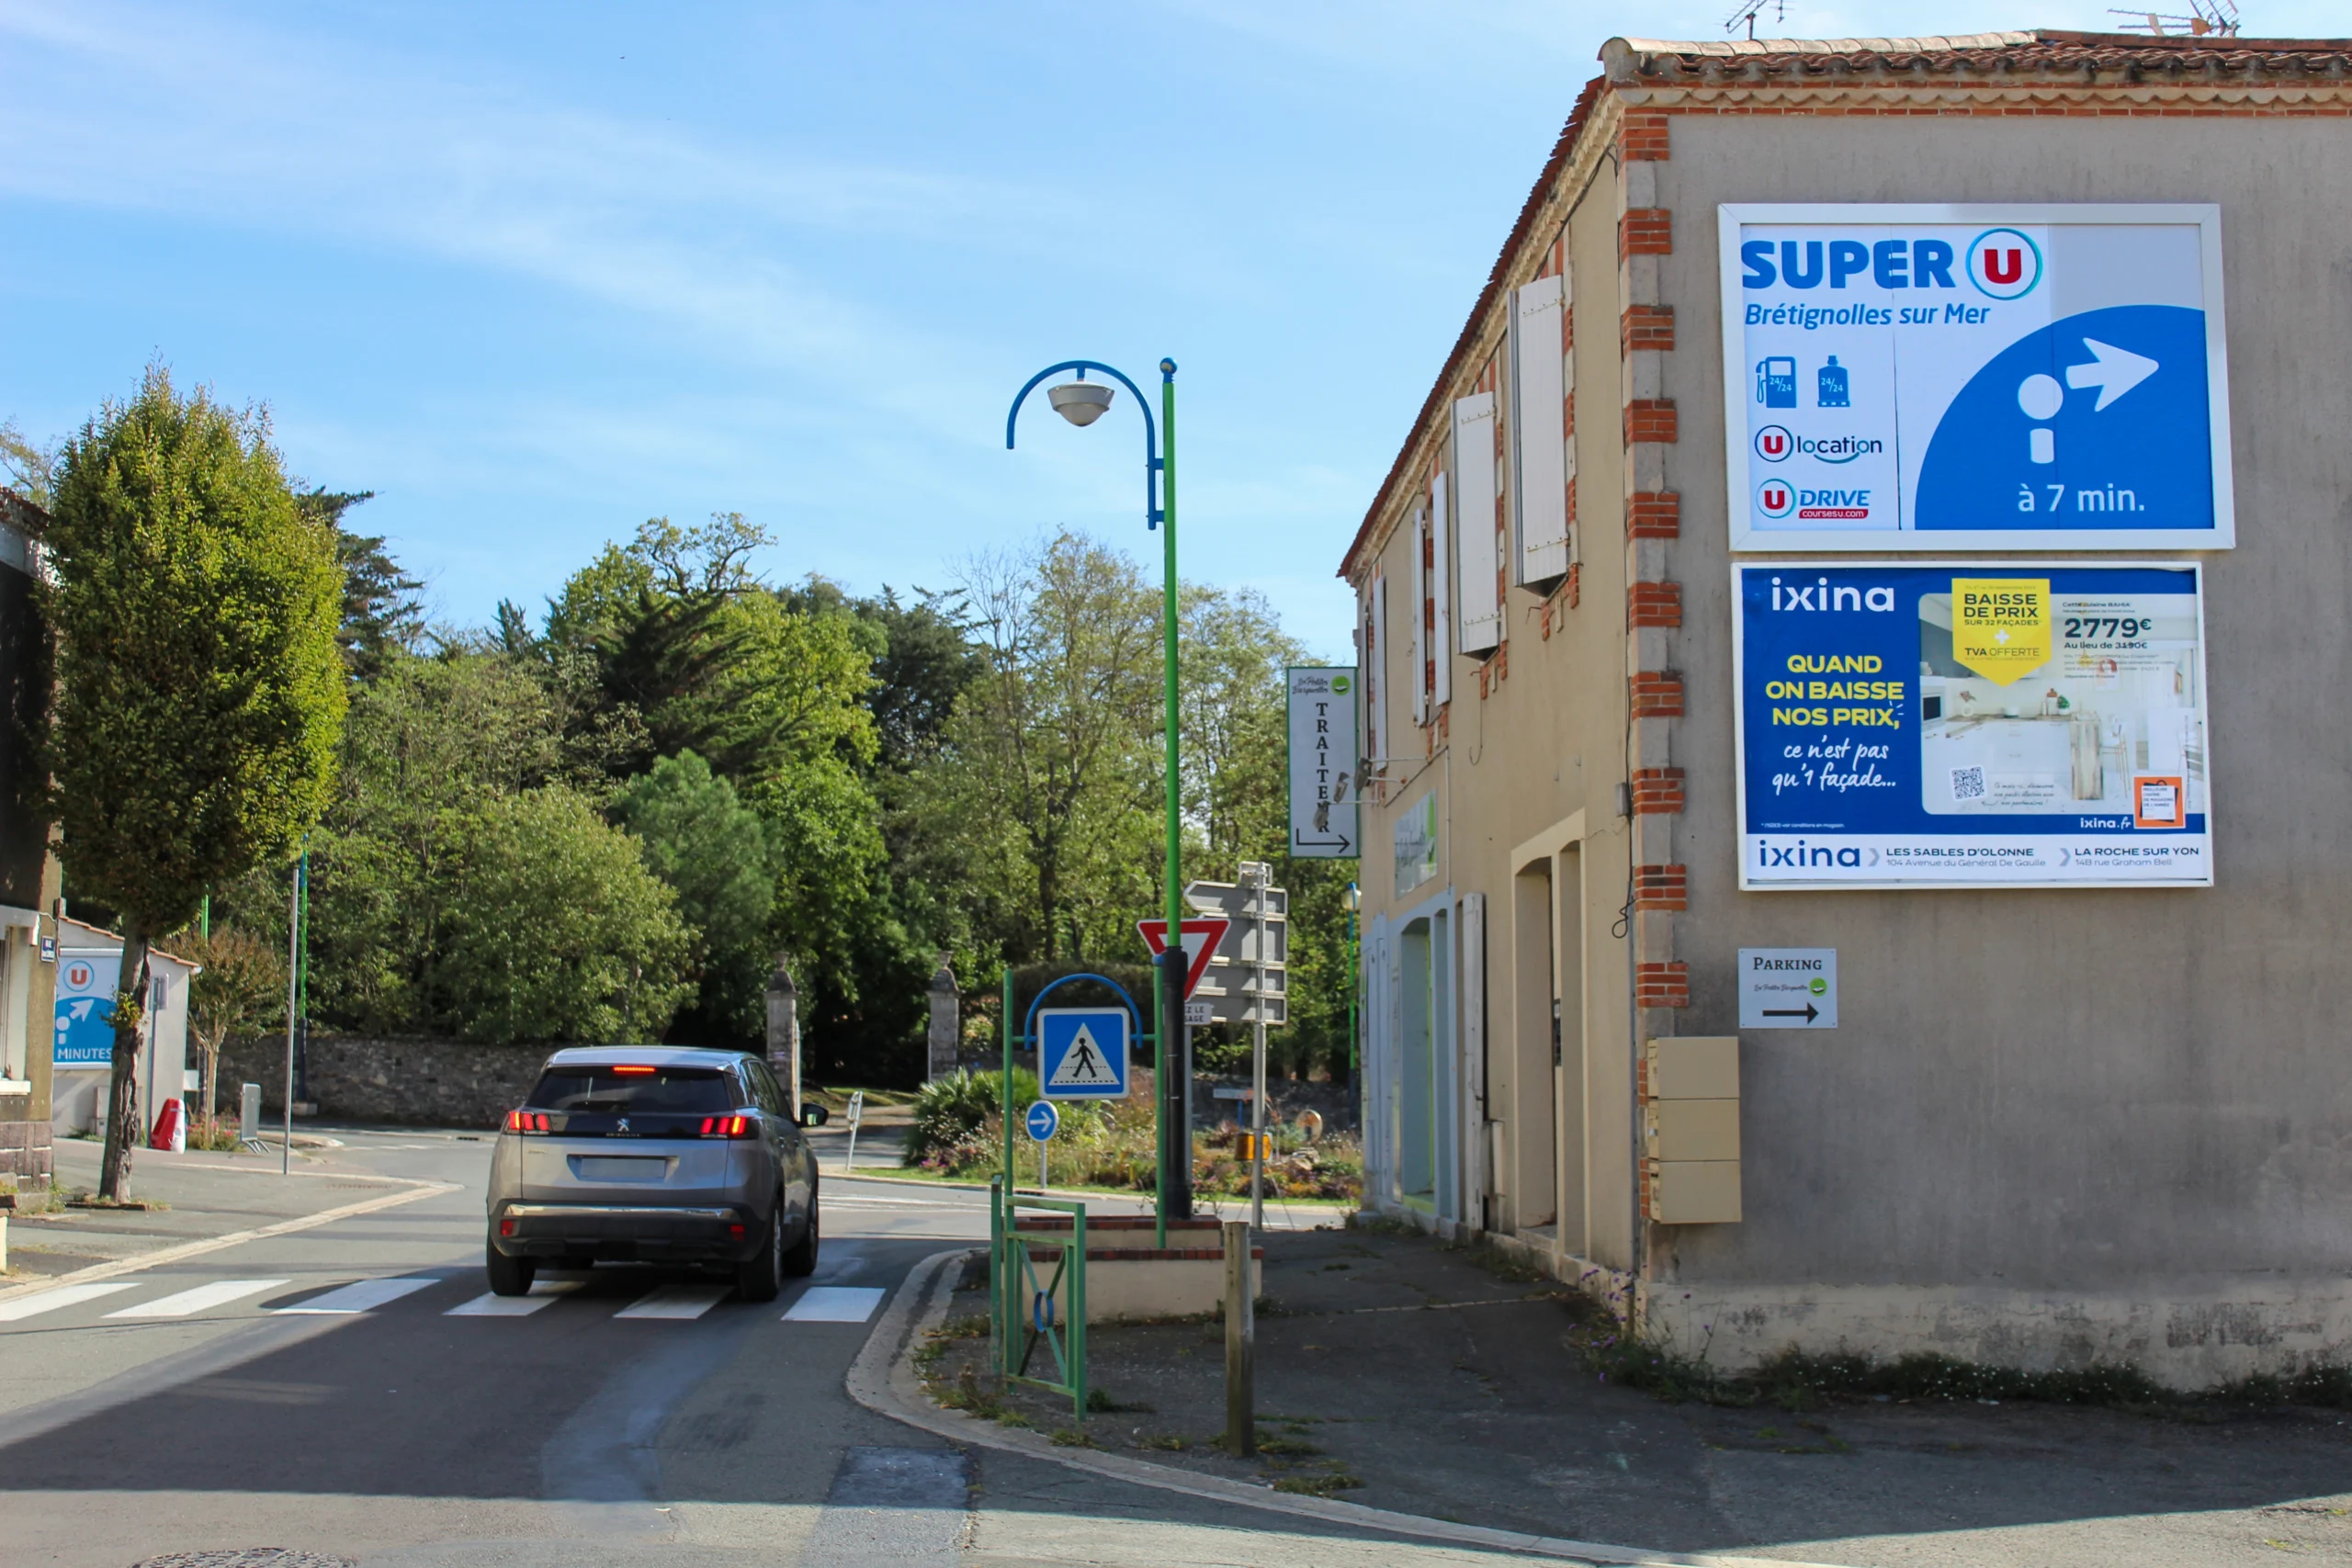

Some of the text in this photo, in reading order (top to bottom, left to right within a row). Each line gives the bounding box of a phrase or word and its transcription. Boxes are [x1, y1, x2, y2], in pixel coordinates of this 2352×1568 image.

[1740, 240, 2021, 289] SUPER U
[1745, 302, 1991, 330] Brétignolles sur Mer
[1770, 378, 1792, 391] 24/24
[1821, 378, 1844, 392] 24/24
[1764, 435, 1883, 454] U location
[1764, 490, 1871, 510] U DRIVE
[2018, 483, 2145, 512] à 7 min.
[1802, 510, 1864, 518] coursesu.com
[1771, 577, 1894, 612] ixina
[1964, 593, 2037, 605] BAISSE
[1964, 606, 2039, 618] DE PRIX
[2064, 617, 2152, 638] 2779€
[1964, 648, 2041, 657] TVA OFFERTE
[1787, 654, 1883, 673] QUAND
[1766, 681, 1905, 700] ON BAISSE
[1772, 707, 1900, 729] NOS PRIX,
[1783, 734, 1890, 772] ce n'est pas
[1315, 702, 1330, 833] TRAITER
[1819, 761, 1896, 793] façade...
[2080, 816, 2132, 829] ixina.fr
[1759, 840, 1860, 867] ixina
[1886, 848, 2034, 856] LES SABLES D'OLONNE
[2075, 848, 2092, 856] LA
[2095, 848, 2140, 856] ROCHE
[2173, 847, 2199, 855] YON
[1958, 858, 1996, 866] Général
[1753, 956, 1823, 970] PARKING
[71, 969, 87, 985] U
[57, 1047, 112, 1060] MINUTES
